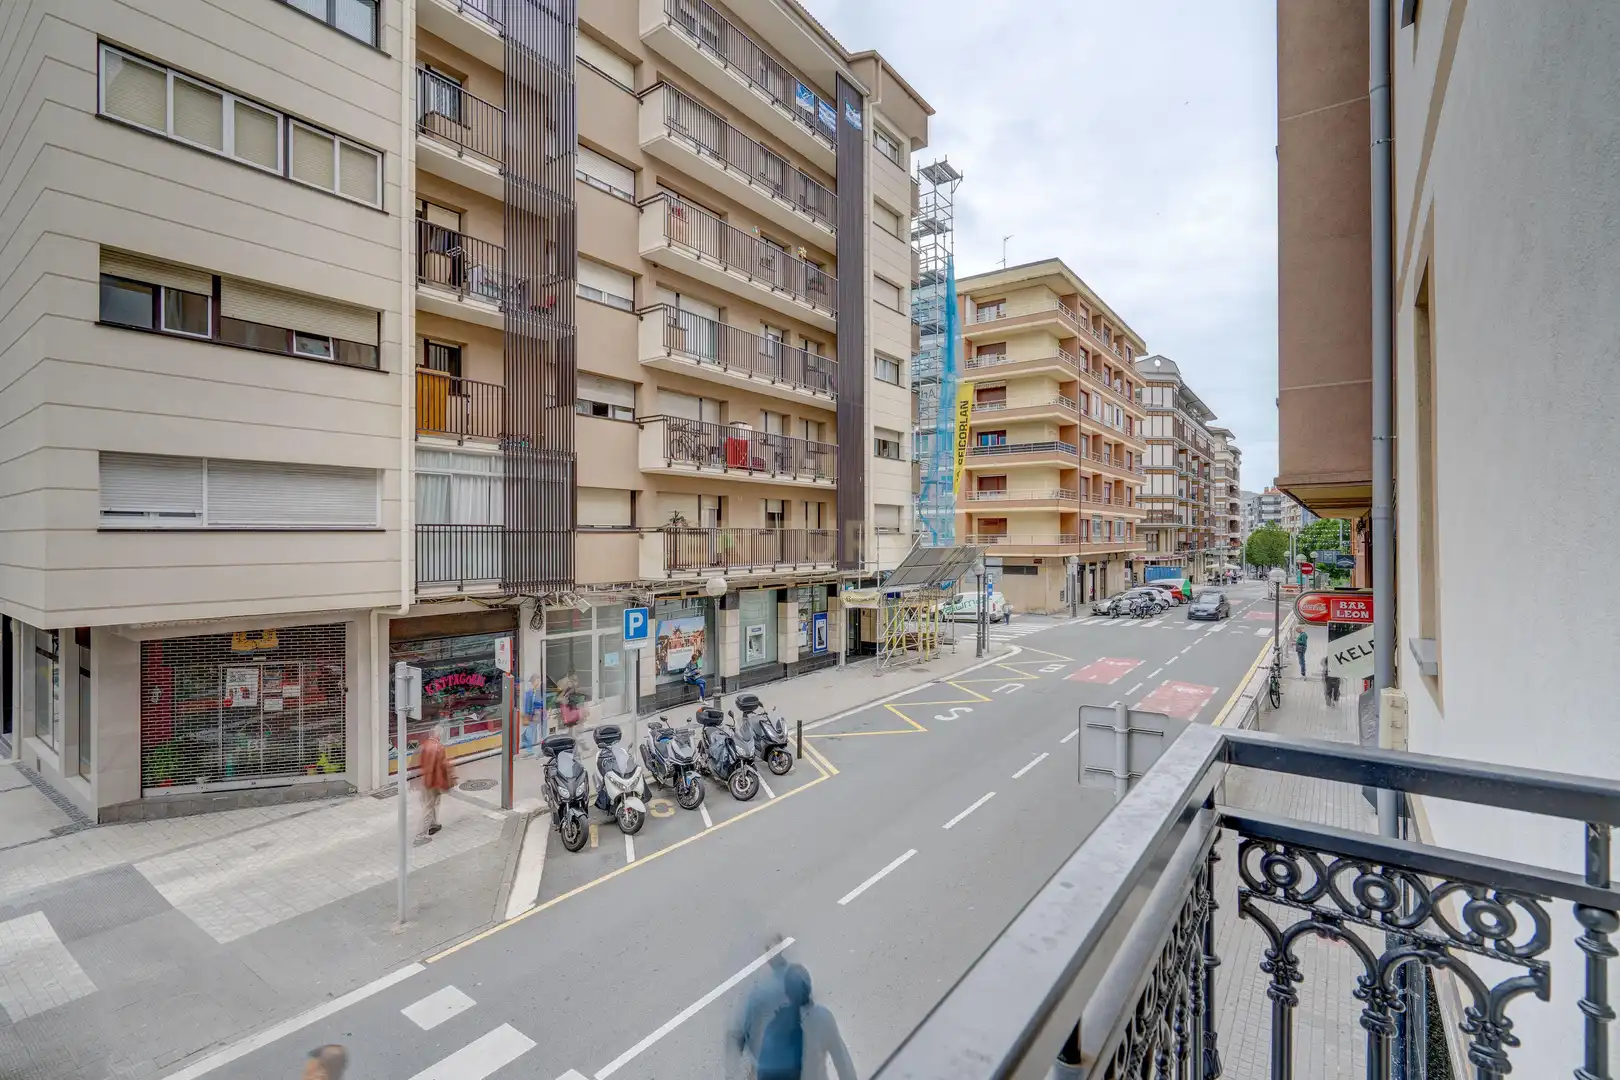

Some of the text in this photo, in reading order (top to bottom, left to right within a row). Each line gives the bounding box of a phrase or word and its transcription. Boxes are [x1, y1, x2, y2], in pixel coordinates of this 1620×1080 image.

[1339, 601, 1367, 610] BAR
[1336, 610, 1370, 619] LEON
[629, 612, 644, 636] P
